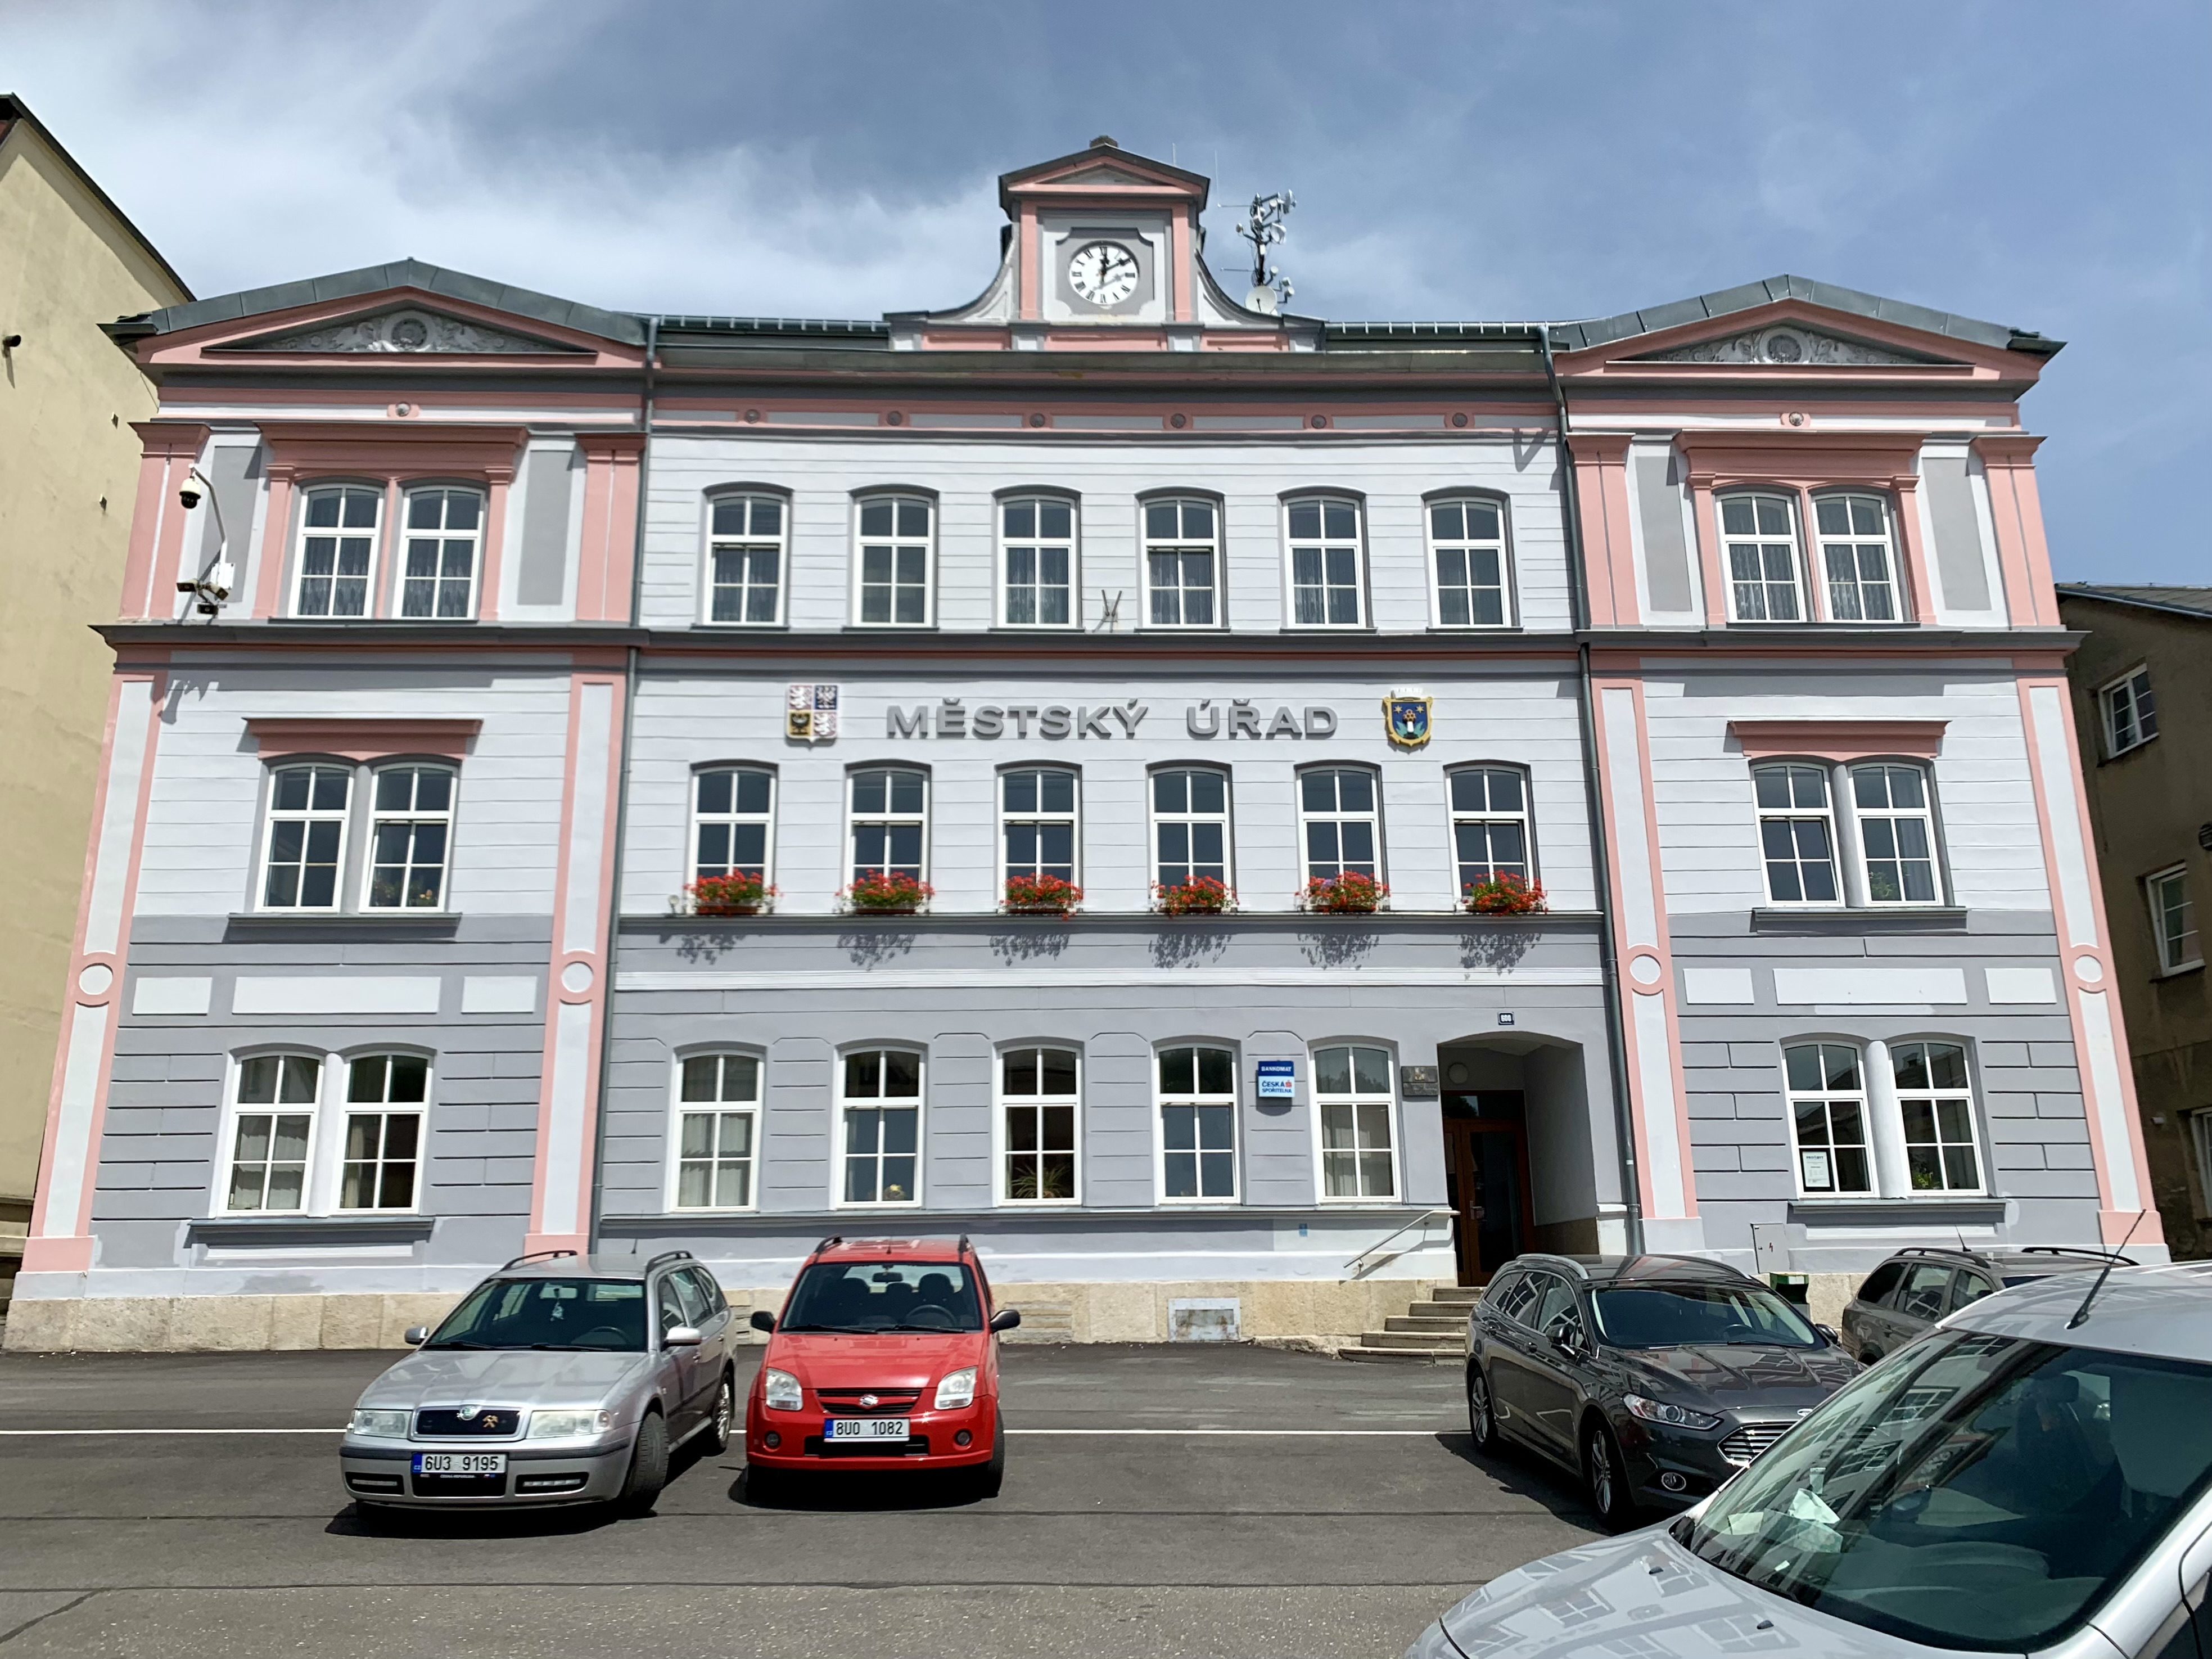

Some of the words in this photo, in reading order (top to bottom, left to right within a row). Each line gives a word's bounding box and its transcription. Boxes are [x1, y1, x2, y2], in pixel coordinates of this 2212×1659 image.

[886, 697, 1149, 740] MĚSTSKÝ
[1186, 698, 1338, 740] ÚŘAD
[872, 1421, 903, 1435] 1082
[425, 1455, 451, 1471] 6U3
[462, 1455, 499, 1471] 9195
